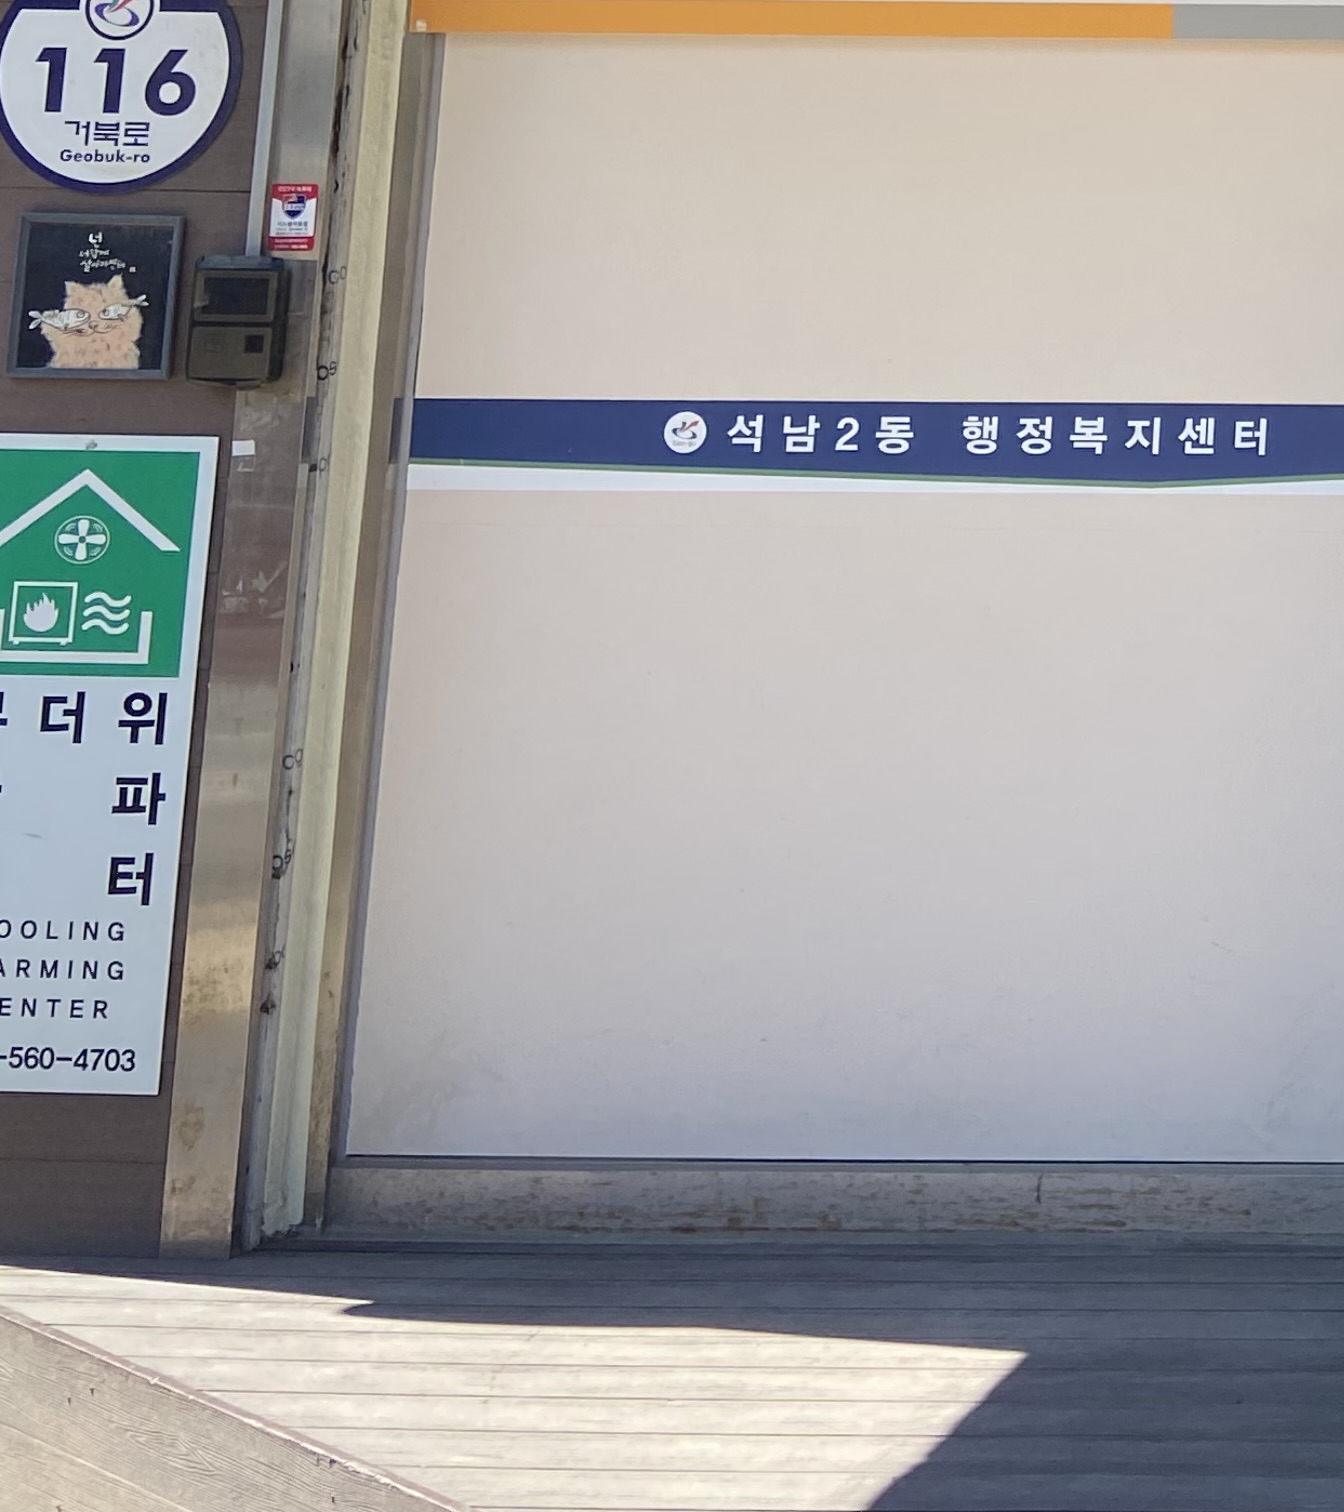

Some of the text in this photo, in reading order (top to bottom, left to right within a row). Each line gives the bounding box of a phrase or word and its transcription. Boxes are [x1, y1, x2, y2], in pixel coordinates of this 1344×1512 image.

[36, 47, 196, 116] 116
[64, 121, 150, 146] 거북로
[60, 149, 150, 163] Geobuk-ro
[727, 414, 1268, 456] 석남2동 행정복지센터
[0, 691, 168, 746] 더위
